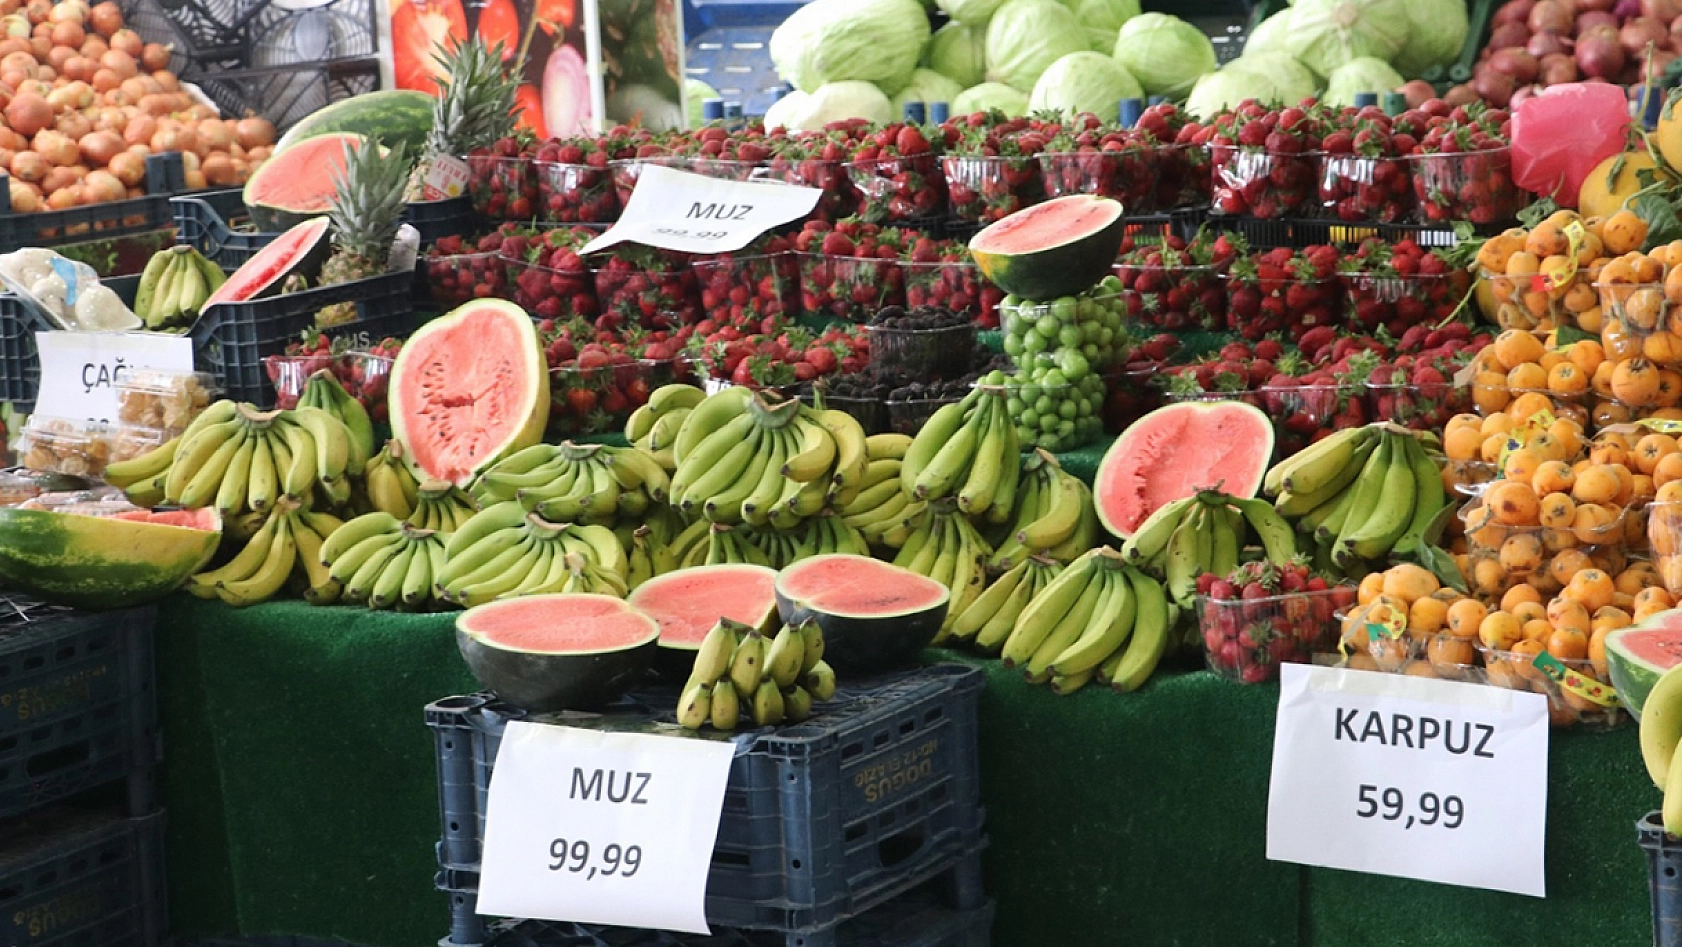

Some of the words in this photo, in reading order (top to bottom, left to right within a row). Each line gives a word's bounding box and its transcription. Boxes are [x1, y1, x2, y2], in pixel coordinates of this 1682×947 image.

[685, 201, 754, 221] MUZ
[82, 356, 151, 394] ÇAĞ
[1334, 707, 1495, 759] KARPUZ
[569, 767, 651, 804] MUZ
[1356, 783, 1464, 830] 59,99
[549, 838, 642, 880] 99,99
